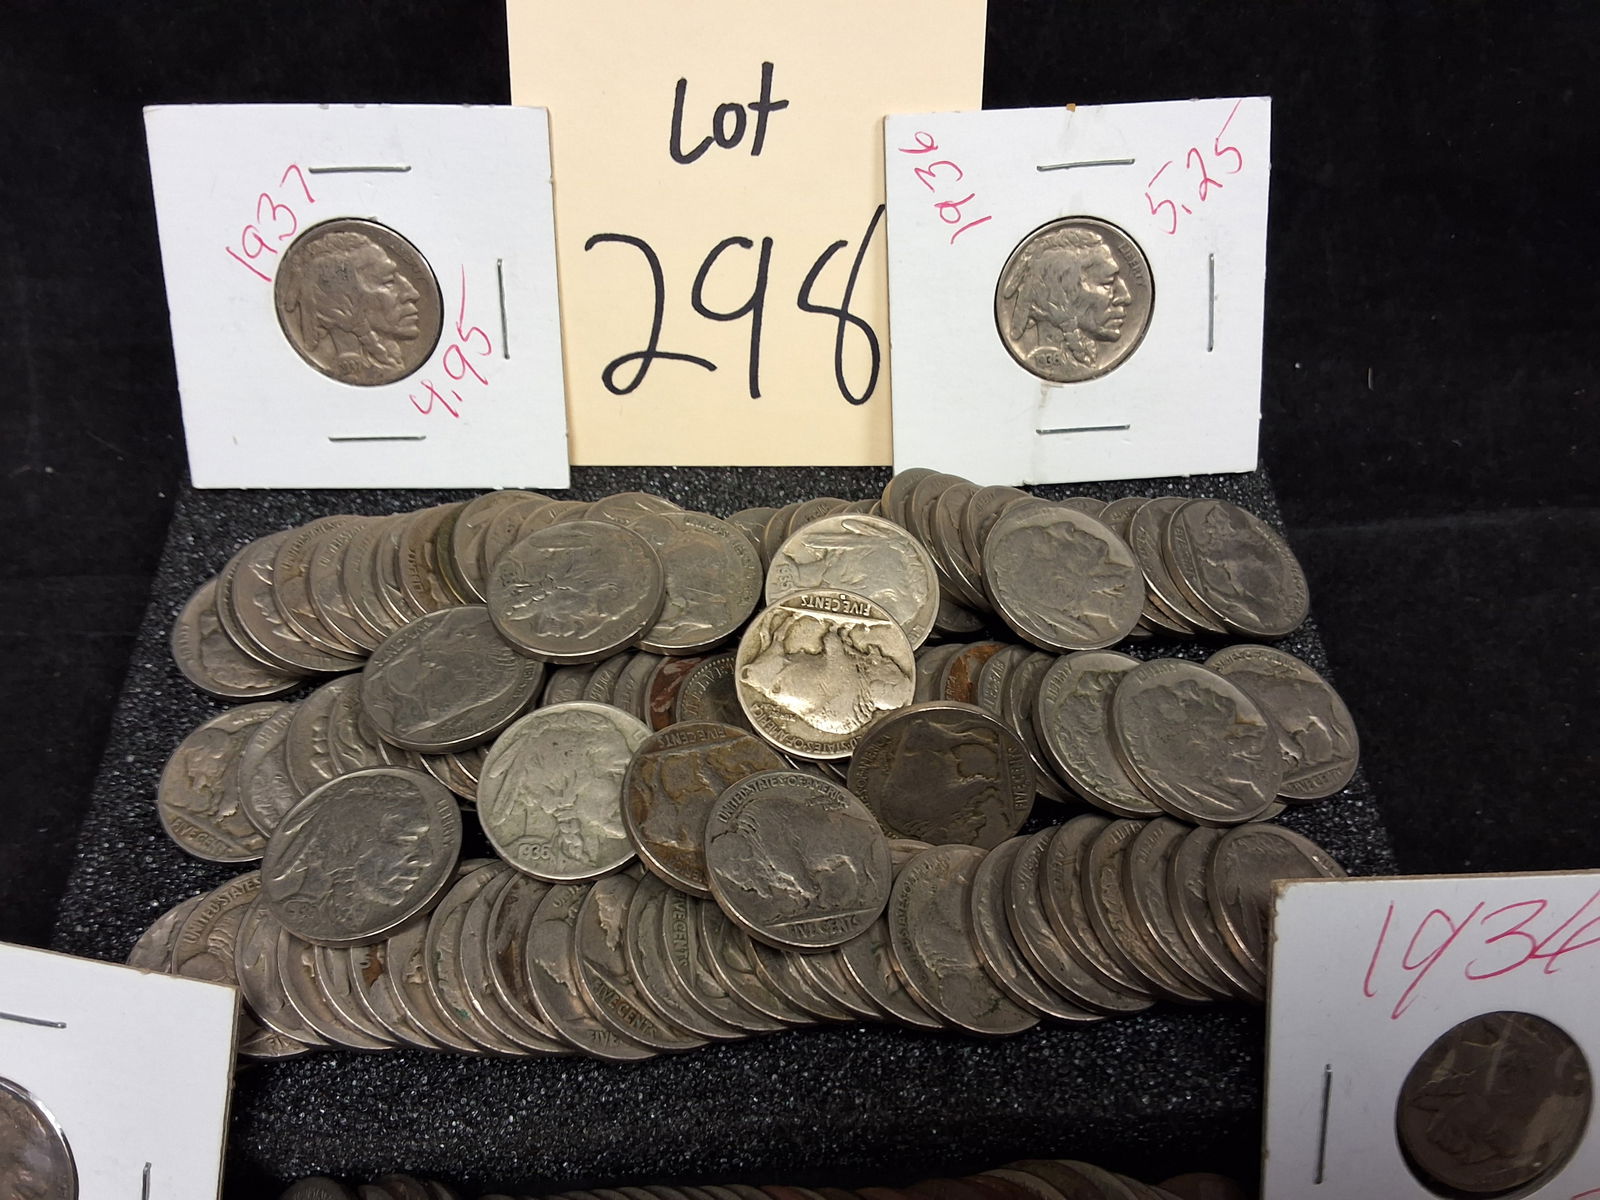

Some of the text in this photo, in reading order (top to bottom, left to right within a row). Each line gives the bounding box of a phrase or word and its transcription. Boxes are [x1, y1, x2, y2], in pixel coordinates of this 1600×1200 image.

[669, 61, 790, 165] Lot
[225, 163, 316, 283] 1937
[899, 131, 993, 244] 1936
[584, 203, 886, 406] 298
[801, 594, 872, 617] FIVE CENTS
